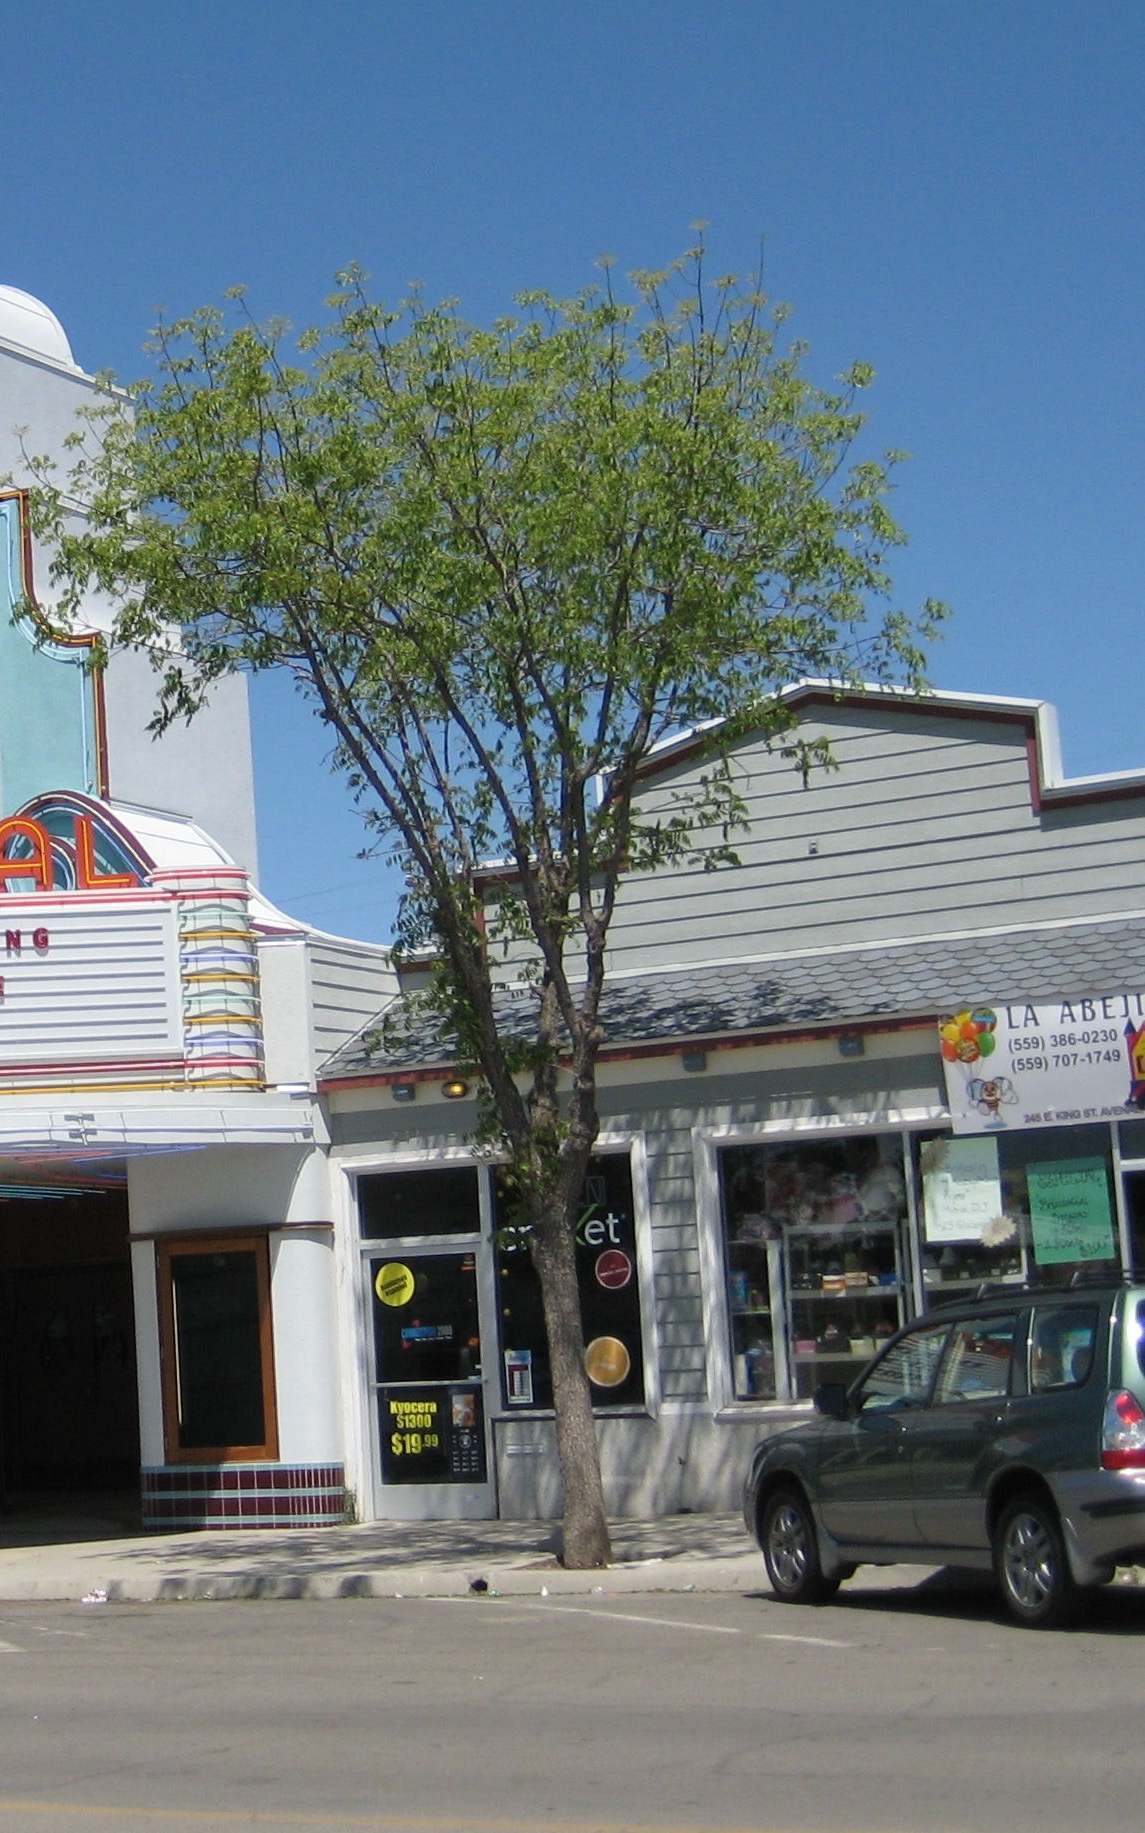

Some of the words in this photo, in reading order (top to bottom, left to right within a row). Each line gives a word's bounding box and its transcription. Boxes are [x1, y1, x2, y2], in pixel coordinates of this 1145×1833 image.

[1006, 1004, 1040, 1030] LA
[1008, 1036, 1045, 1054] (559)
[1050, 1028, 1118, 1048] 386-0230
[1011, 1056, 1048, 1074] (559)
[1052, 1049, 1121, 1068] 707-1749
[1055, 1109, 1081, 1121] KING
[389, 1400, 437, 1415] Kyocera
[391, 1432, 439, 1456] $19.99
